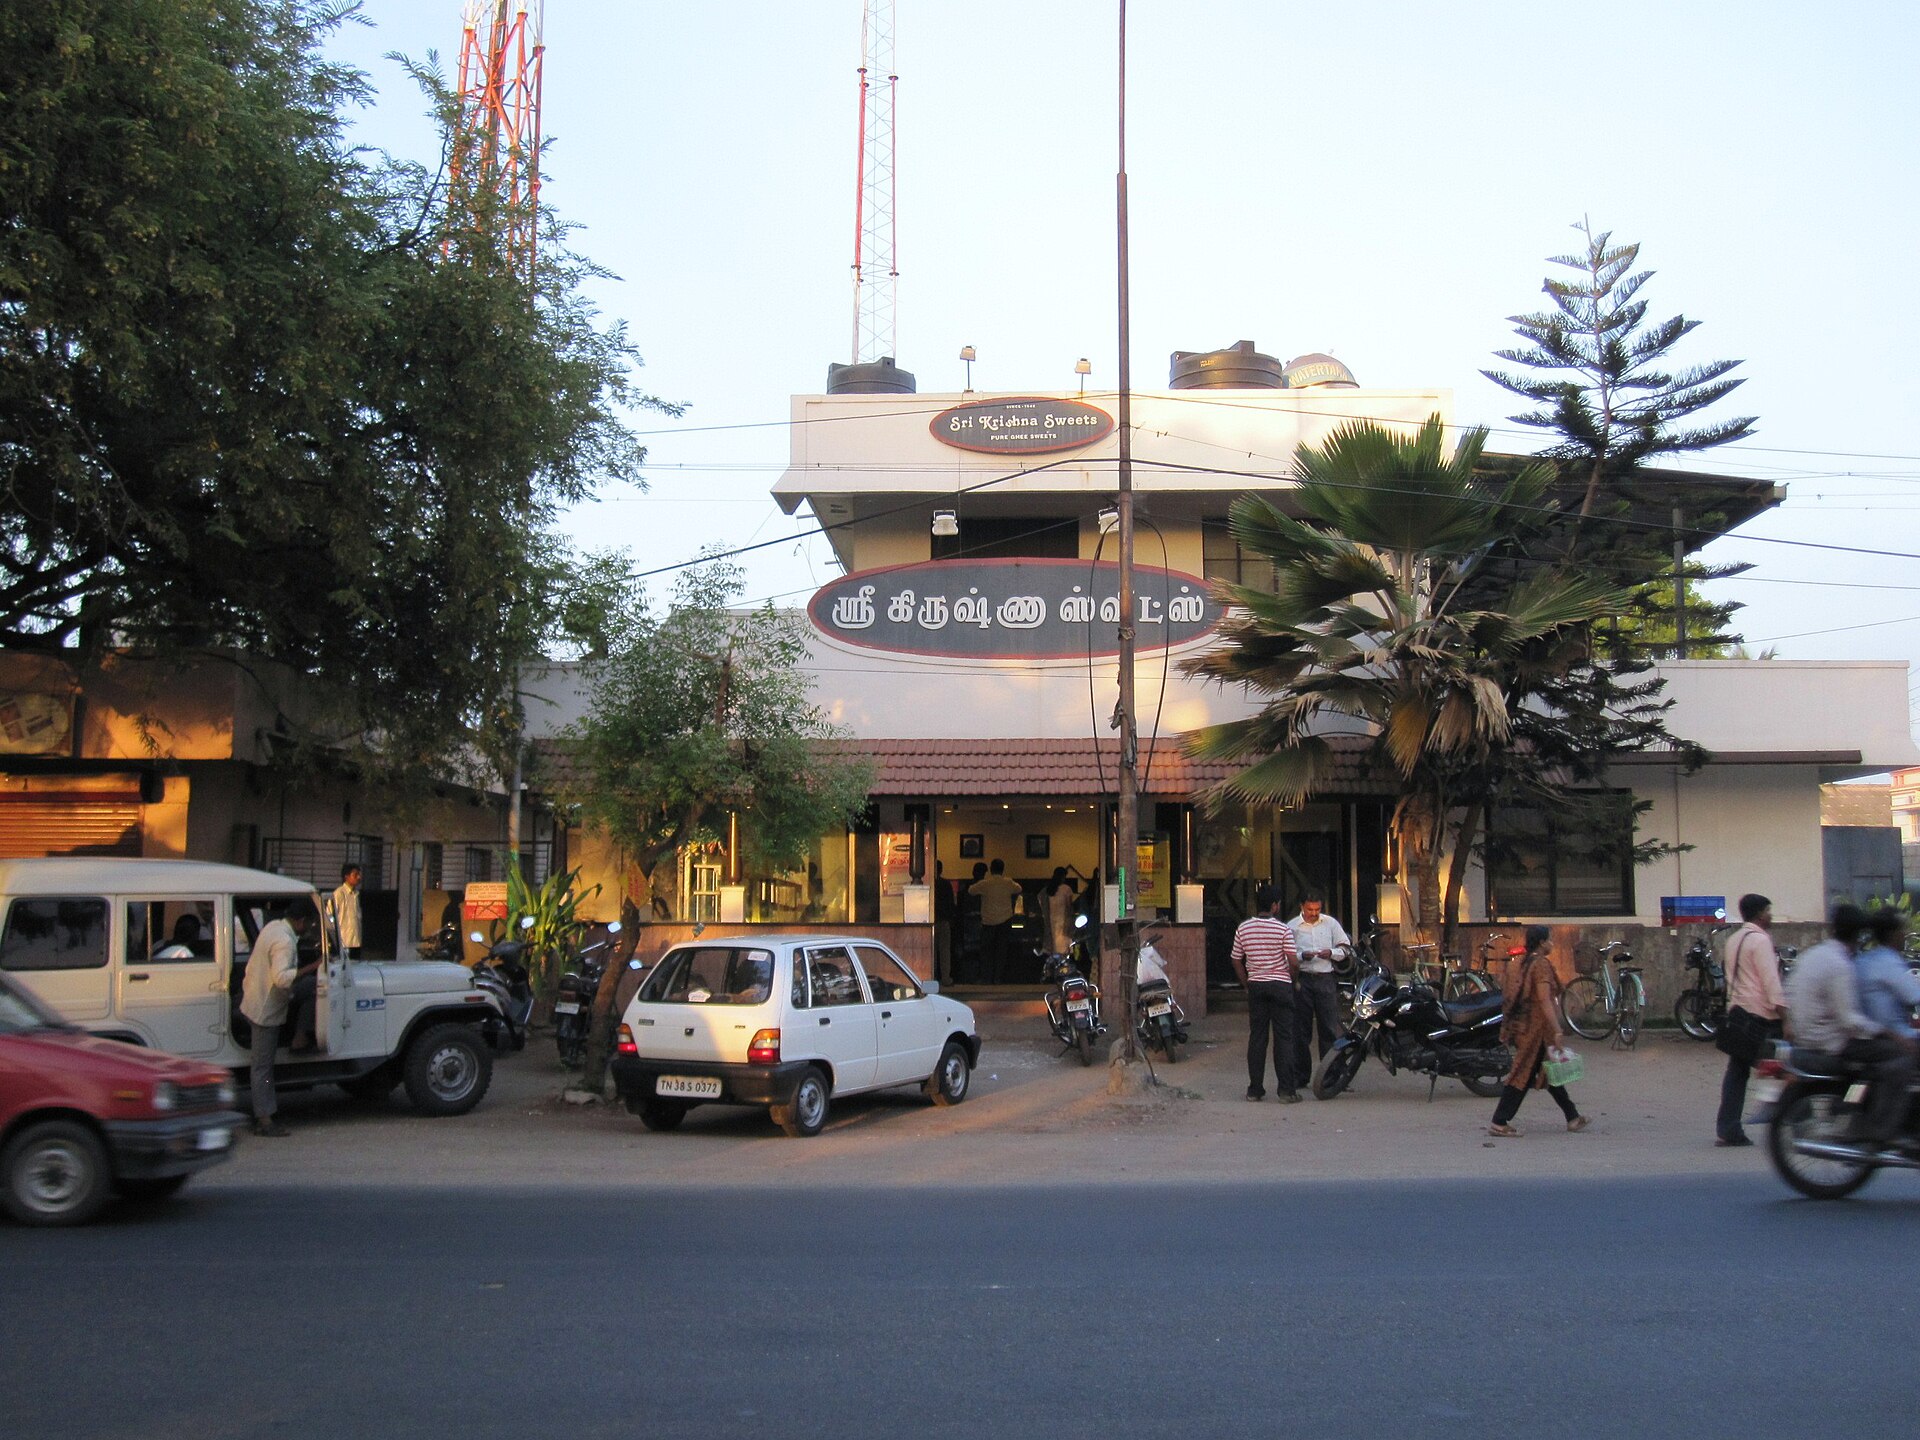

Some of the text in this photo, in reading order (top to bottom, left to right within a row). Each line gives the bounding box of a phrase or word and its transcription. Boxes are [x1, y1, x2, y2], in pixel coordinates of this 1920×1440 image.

[949, 413, 1098, 432] Sri Krishna Sweets
[661, 1080, 717, 1093] TN 38 S 0372
